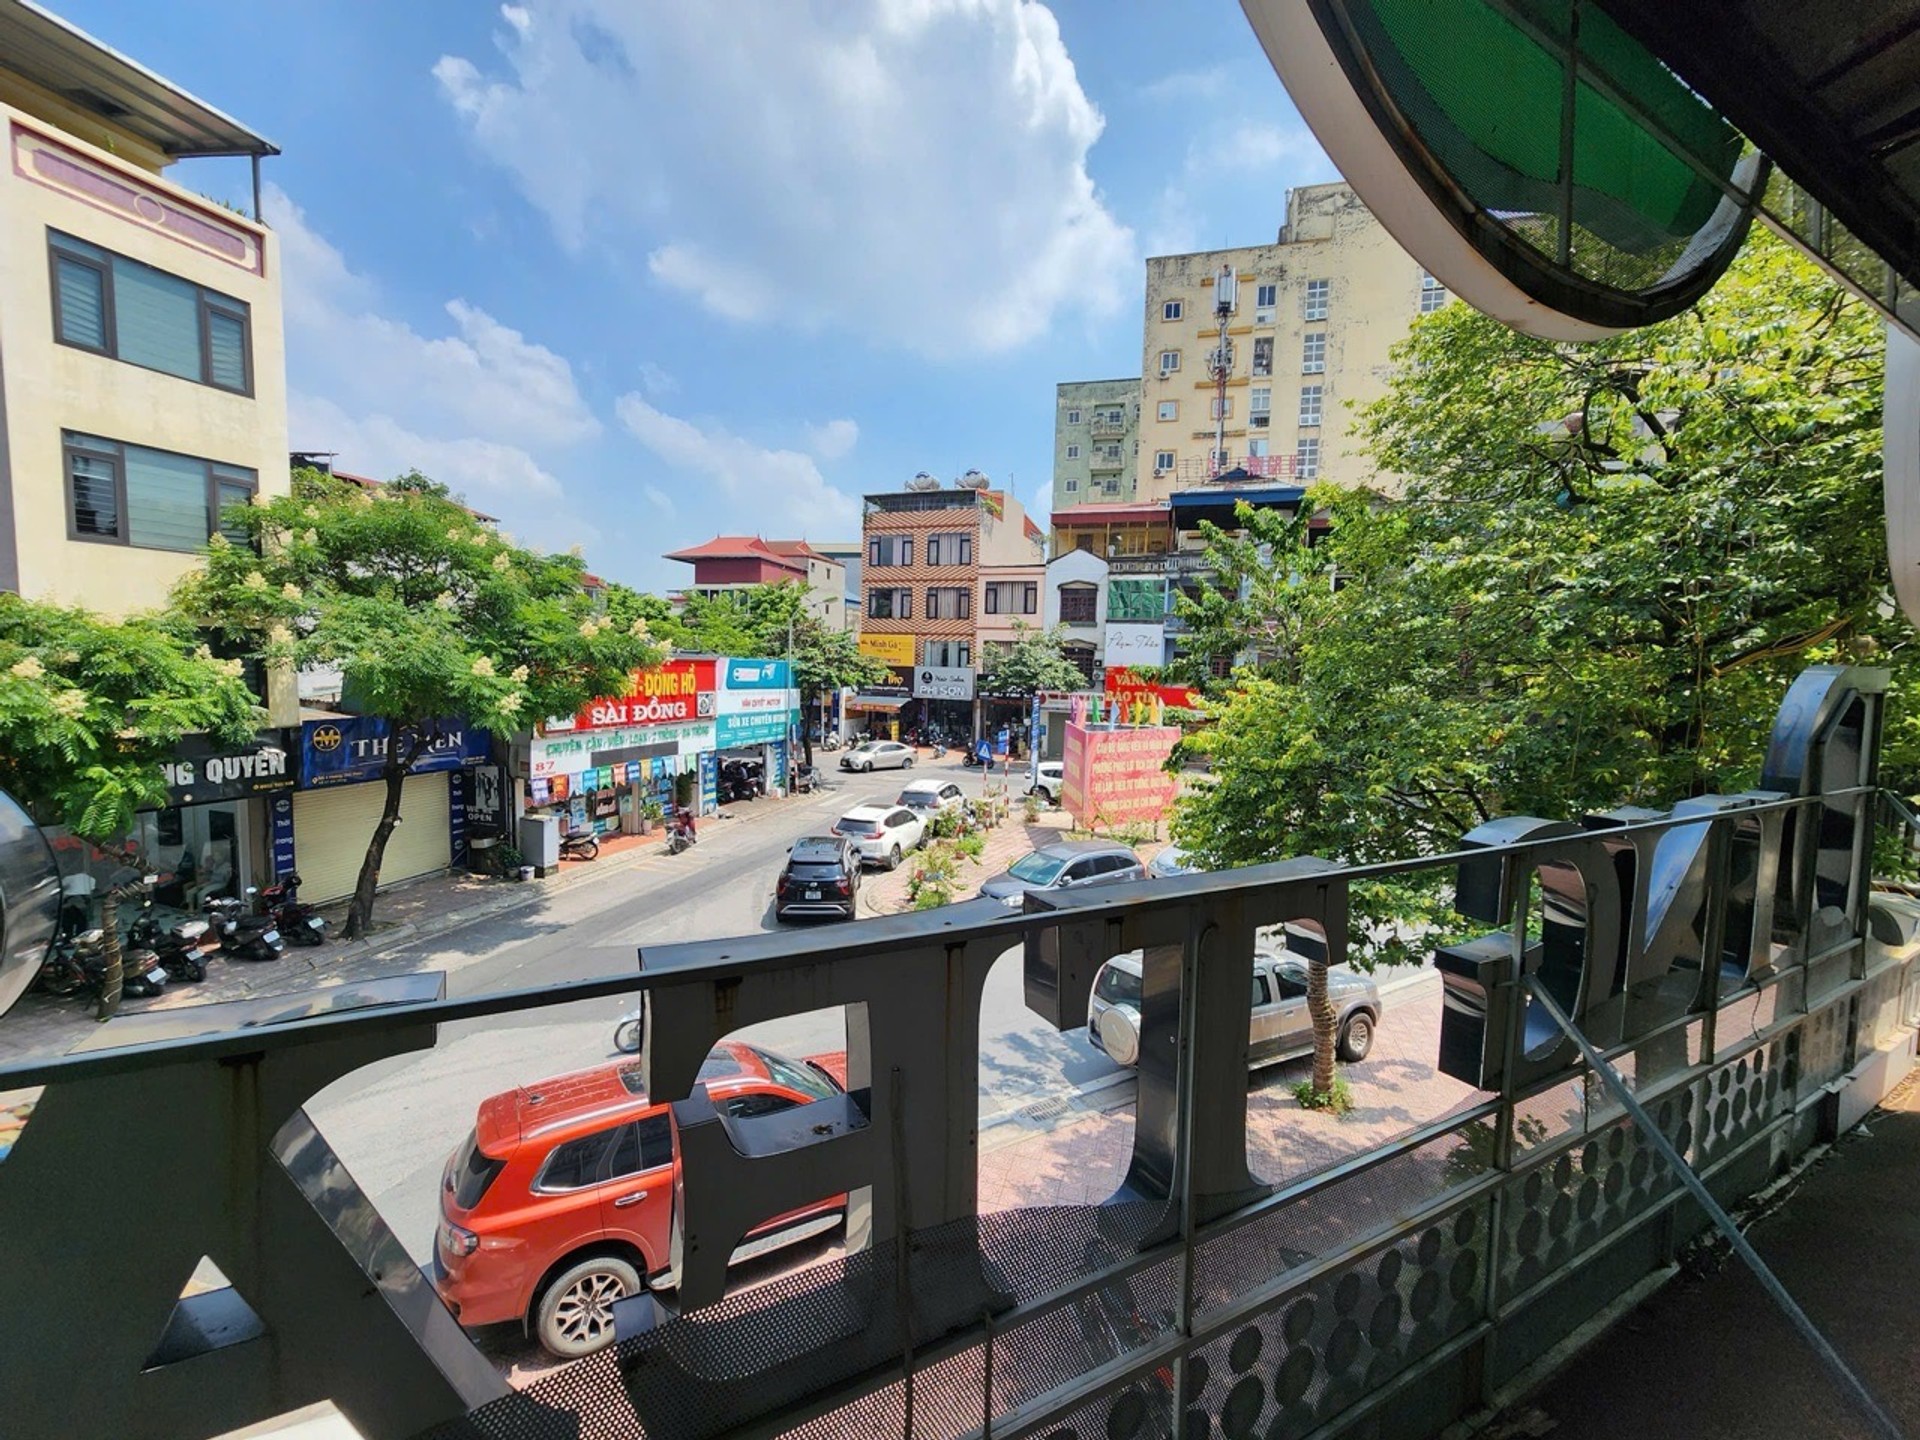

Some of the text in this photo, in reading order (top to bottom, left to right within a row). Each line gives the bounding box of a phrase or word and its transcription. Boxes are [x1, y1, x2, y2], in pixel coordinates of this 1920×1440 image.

[591, 695, 687, 726] SÀI ĐỒNG
[534, 760, 556, 773] 87
